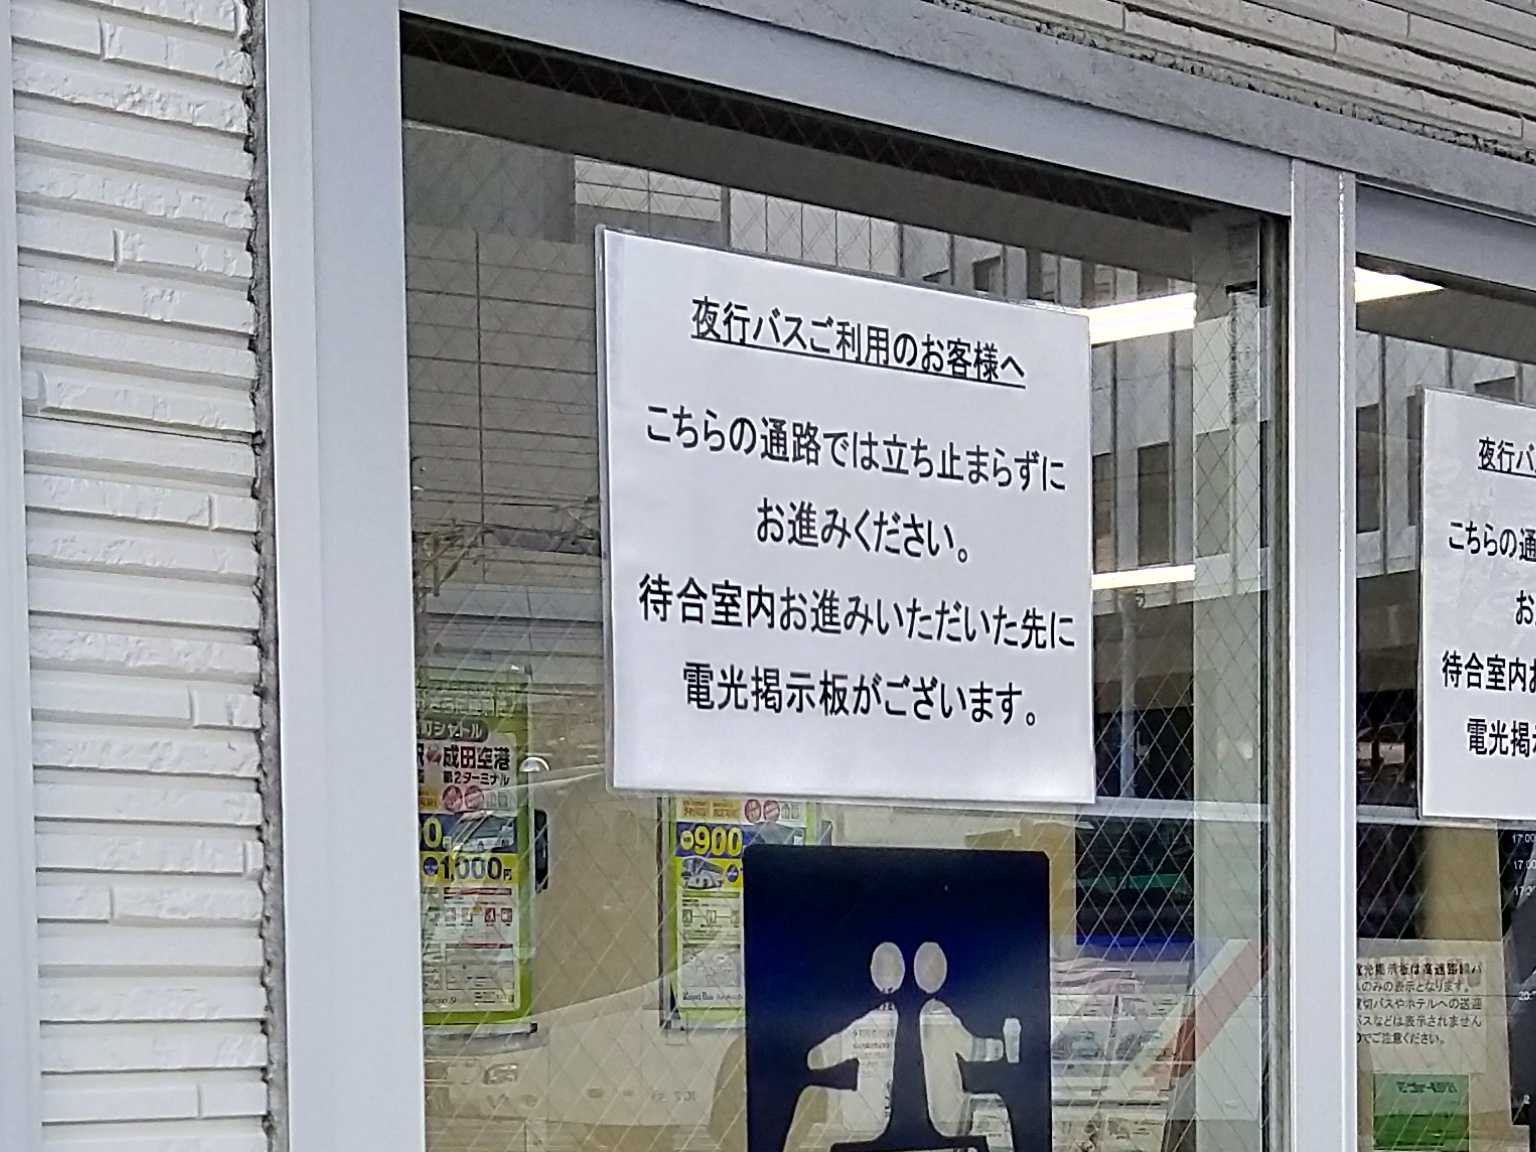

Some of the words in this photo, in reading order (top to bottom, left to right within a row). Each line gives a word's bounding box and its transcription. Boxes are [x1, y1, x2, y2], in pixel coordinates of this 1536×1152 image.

[691, 295, 1026, 387] 夜行バスご利用のお客様へ
[647, 404, 1066, 492] こちらの通路では立ち止まらずに
[757, 497, 969, 564] お進みください。
[639, 572, 1075, 650] 待合室内お進みいただいた先に
[682, 661, 1037, 727] 電光掲示板がございます。
[442, 745, 510, 771] 成田空港
[1357, 980, 1469, 993] のみの表示となります。
